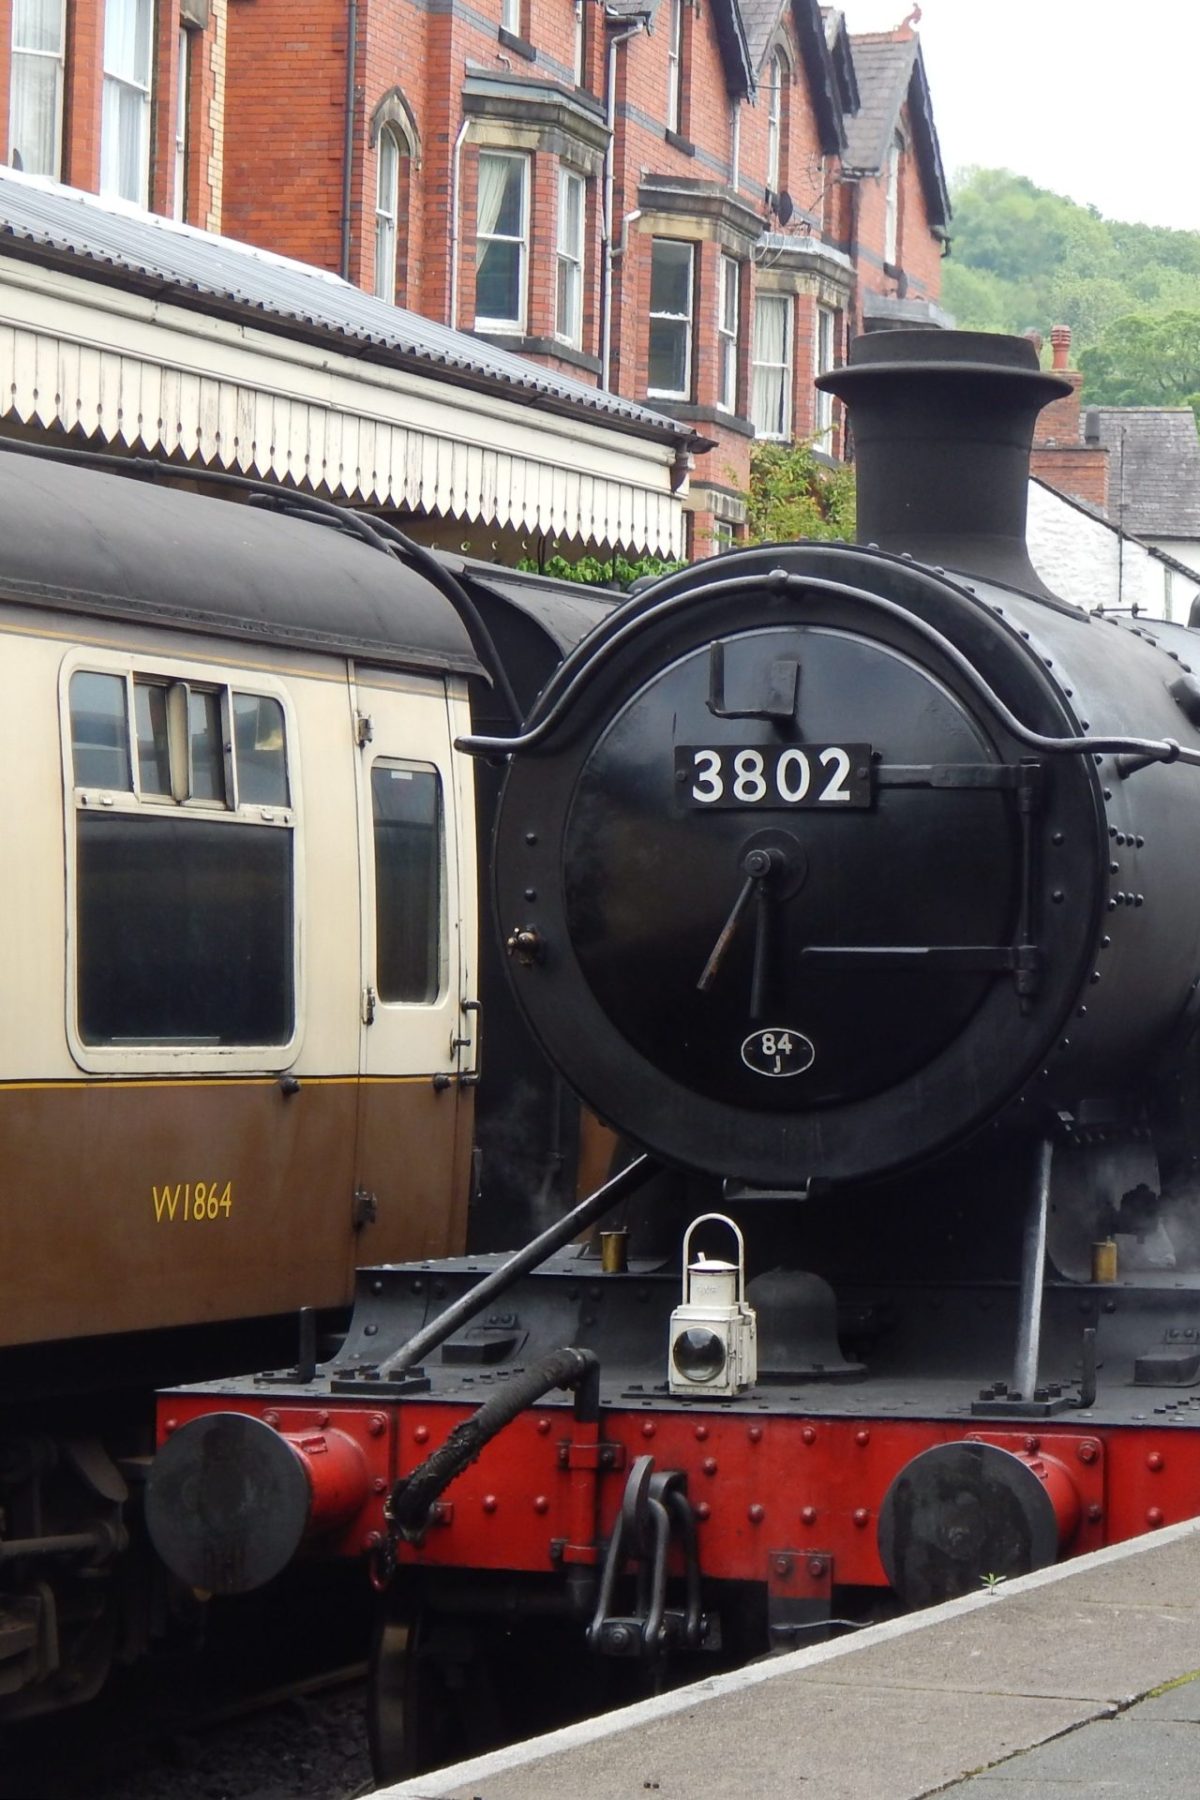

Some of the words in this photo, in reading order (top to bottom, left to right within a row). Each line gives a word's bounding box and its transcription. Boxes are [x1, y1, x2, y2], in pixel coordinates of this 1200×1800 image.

[692, 747, 851, 803] 3802
[761, 1032, 793, 1055] 84
[773, 1055, 782, 1074] J
[152, 1181, 232, 1222] W1864
